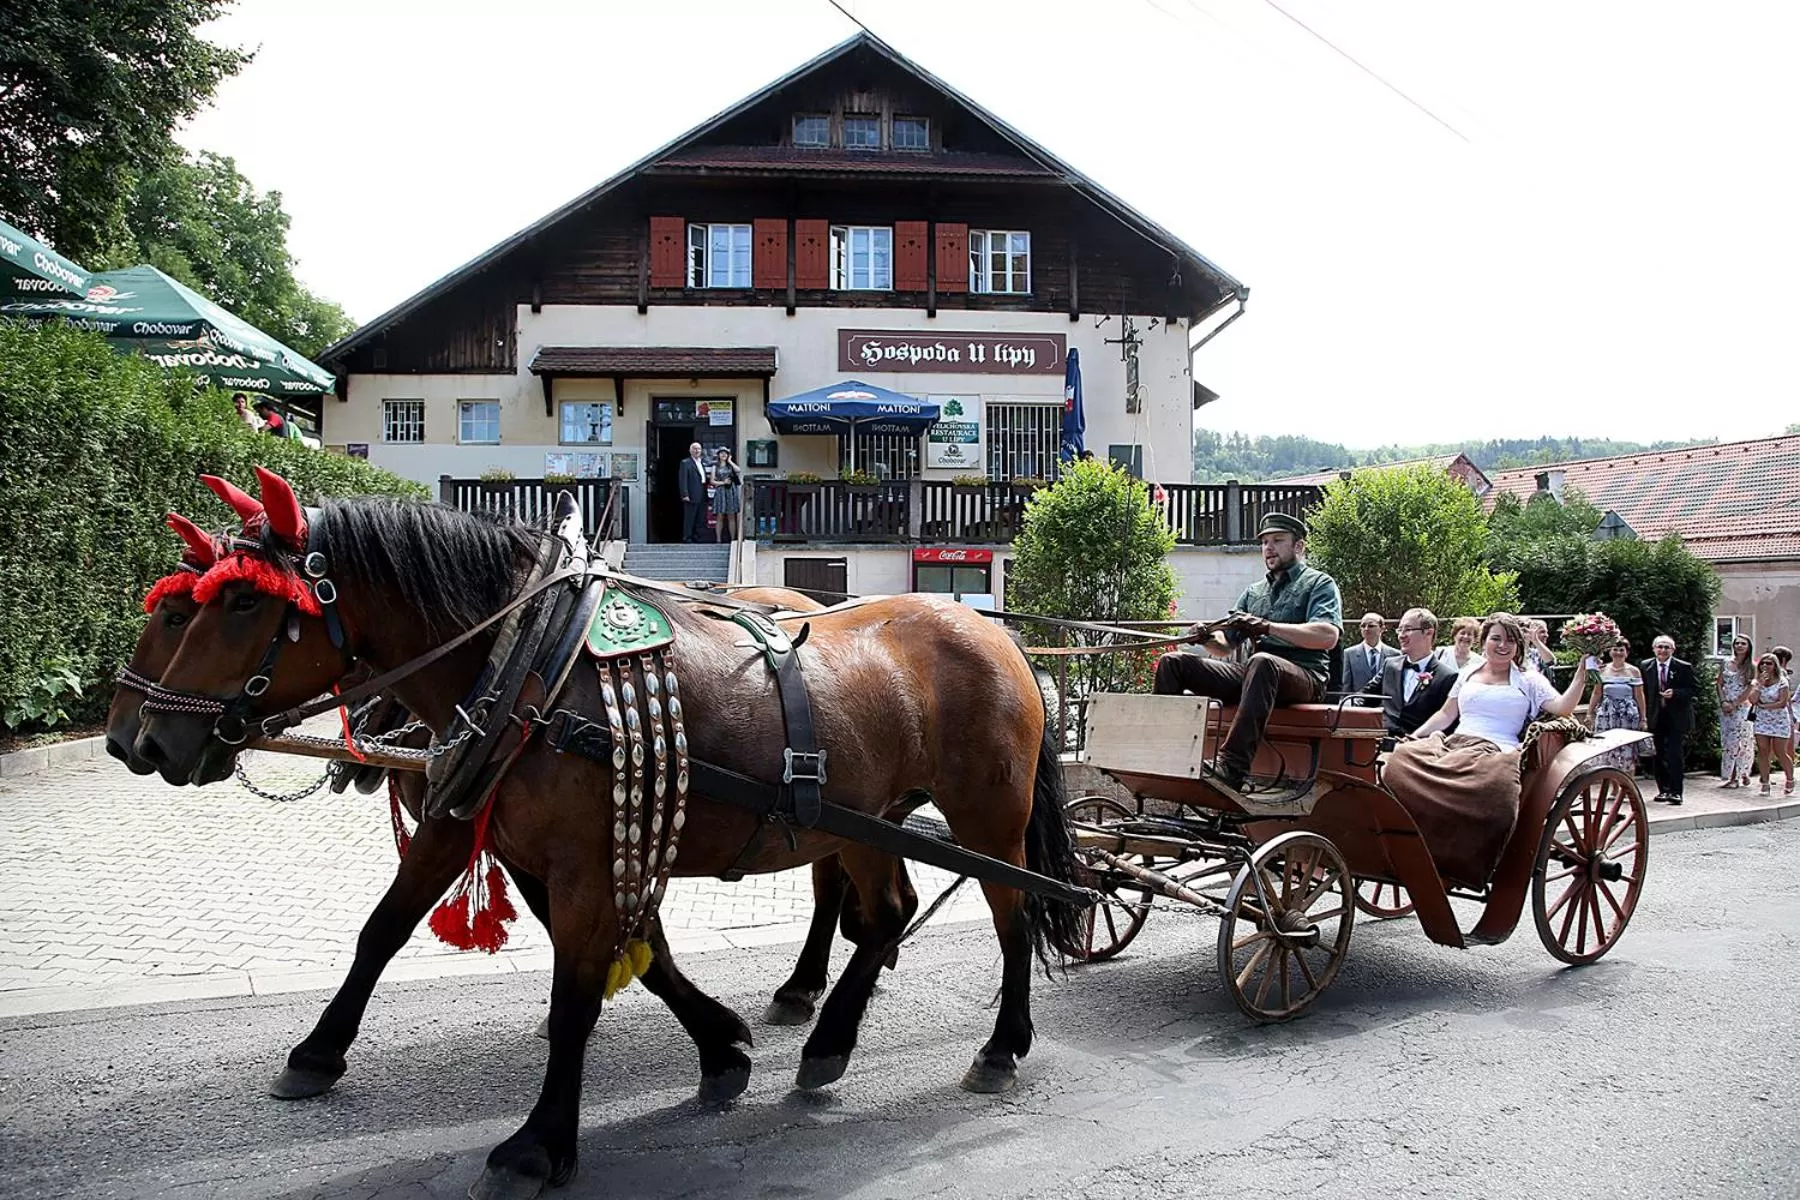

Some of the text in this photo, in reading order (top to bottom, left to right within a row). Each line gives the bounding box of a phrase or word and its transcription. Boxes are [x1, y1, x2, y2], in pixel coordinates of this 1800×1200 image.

[34, 252, 85, 288] Chobovar
[133, 322, 193, 334] Chobovar
[860, 341, 961, 367] Hospoda
[968, 343, 986, 363] U
[787, 403, 831, 412] MATTONI
[877, 405, 921, 414] MATTONI
